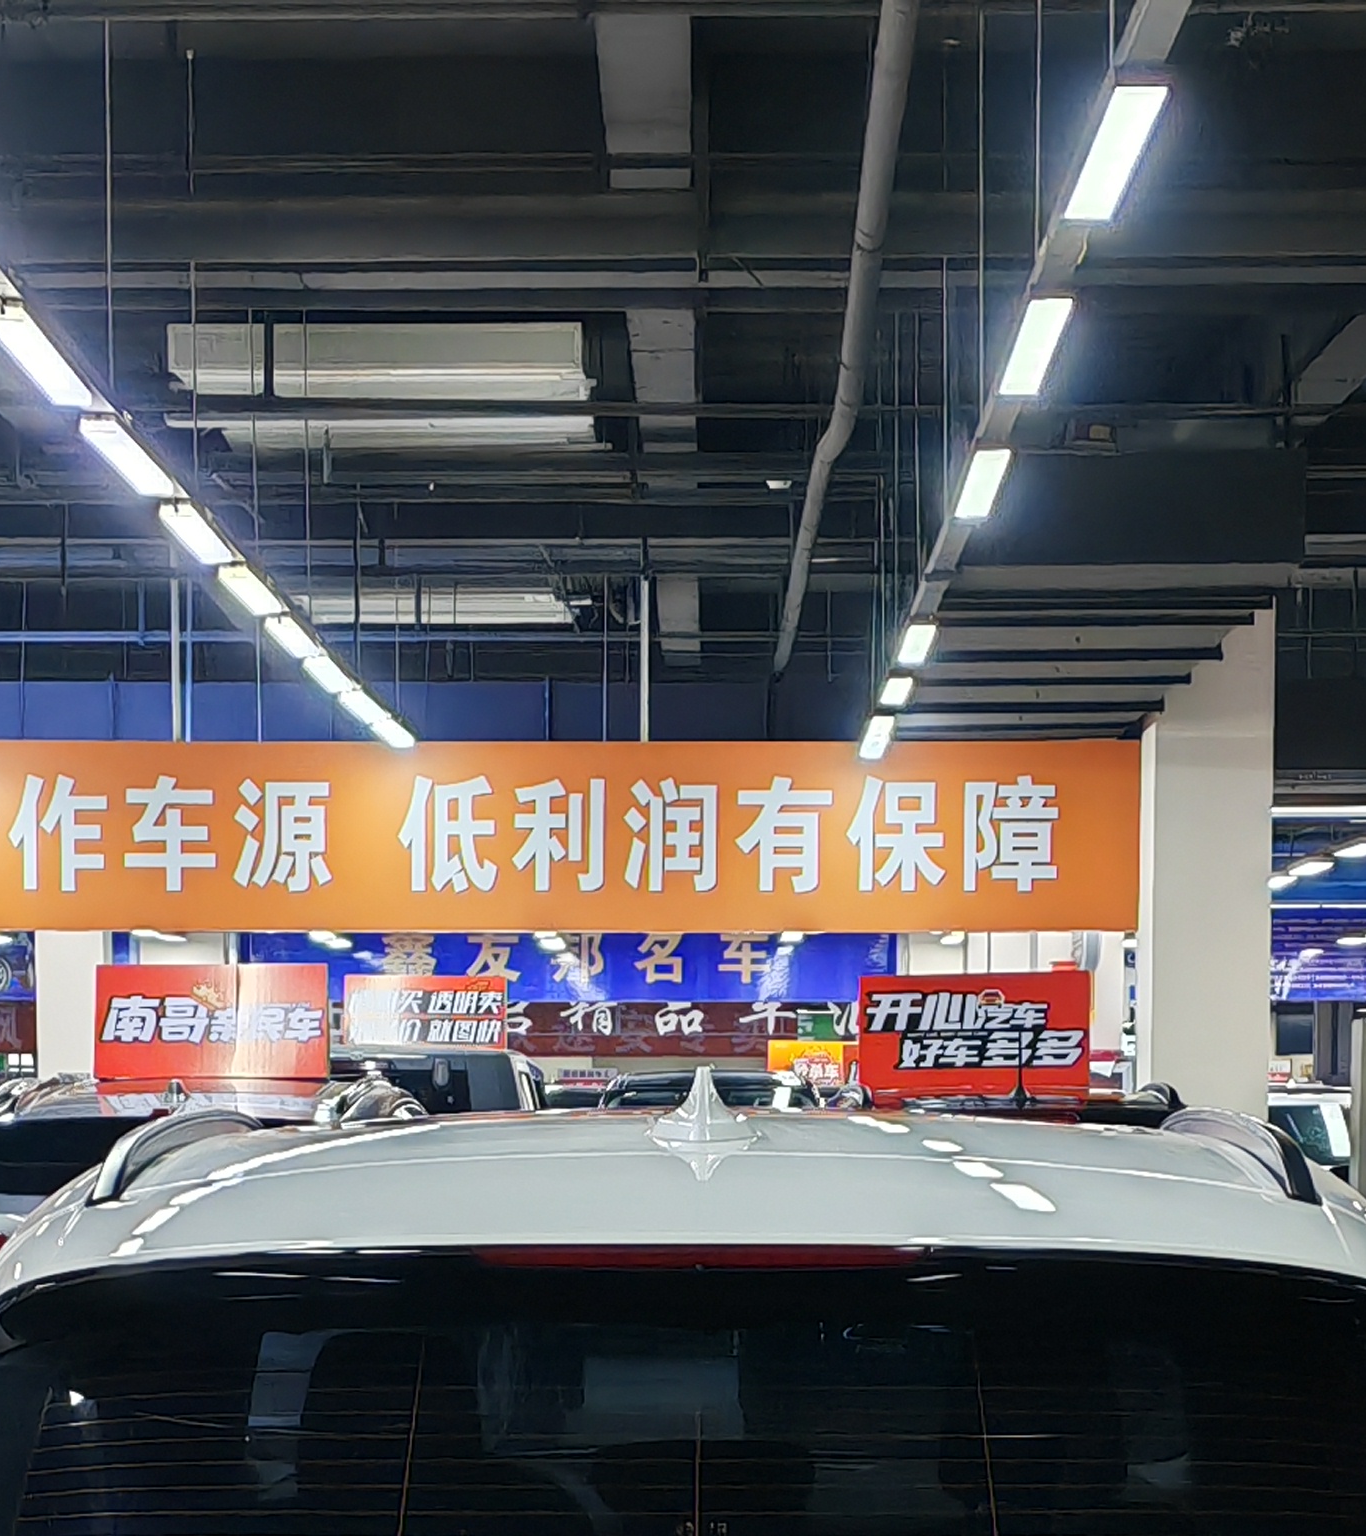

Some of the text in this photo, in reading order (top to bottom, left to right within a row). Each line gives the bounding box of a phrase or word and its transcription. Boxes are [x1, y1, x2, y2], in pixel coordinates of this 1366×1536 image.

[398, 775, 1060, 893] 低利润有保障
[866, 991, 1048, 1031] 开心汽车
[897, 1031, 1085, 1068] 好车多多
